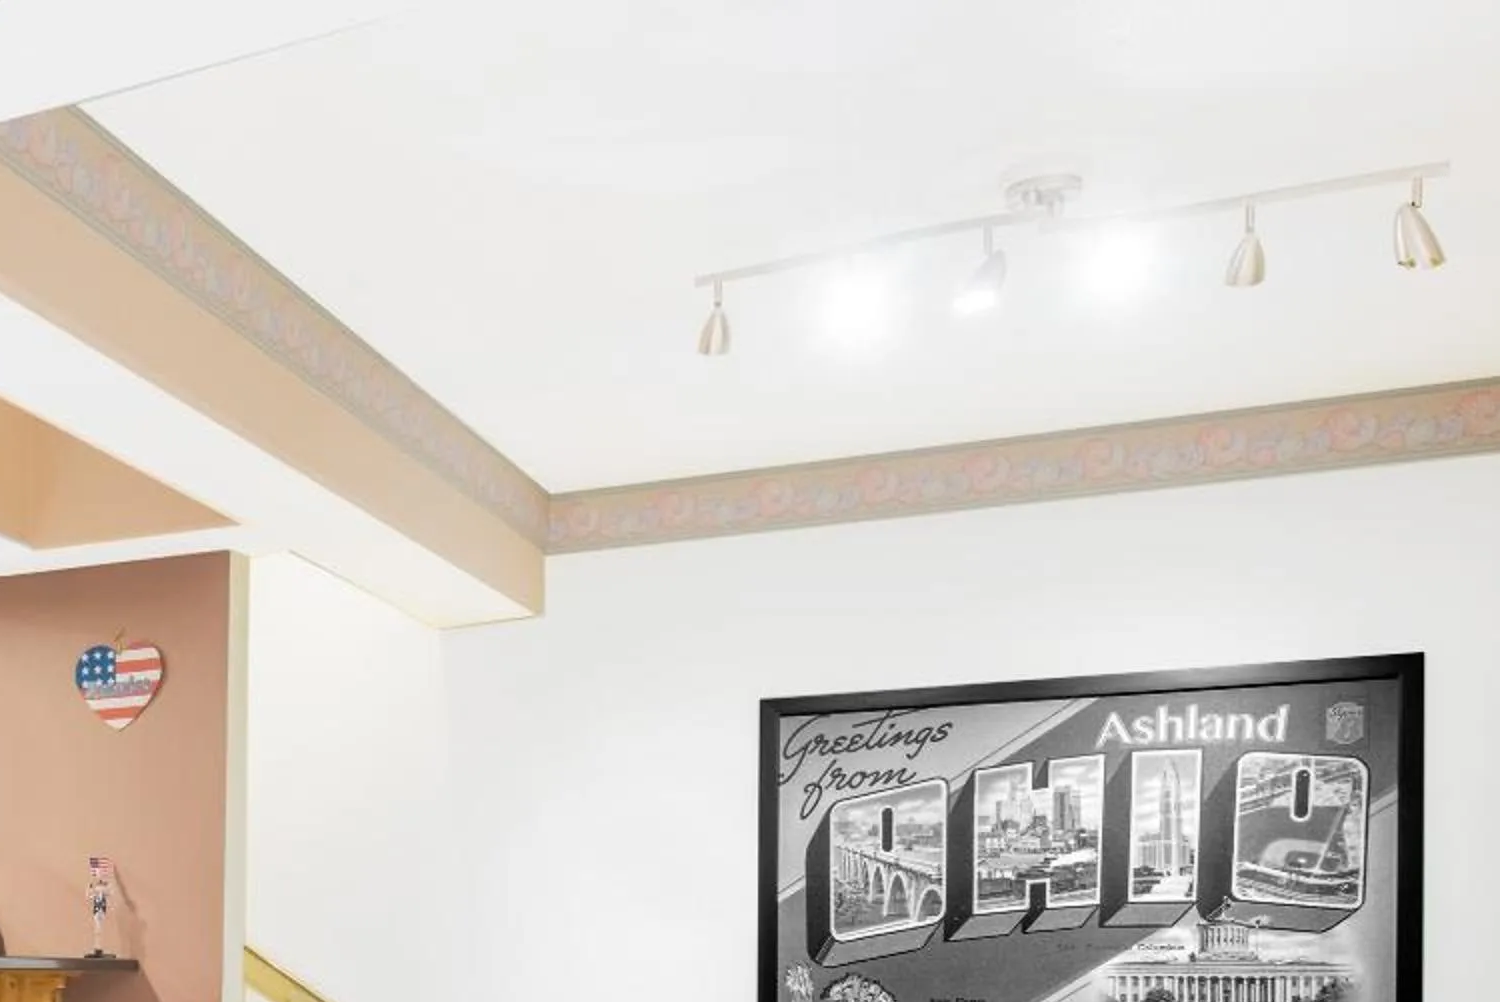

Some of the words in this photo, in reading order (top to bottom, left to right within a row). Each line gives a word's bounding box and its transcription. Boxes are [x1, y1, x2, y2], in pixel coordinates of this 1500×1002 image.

[777, 706, 953, 787] Greetings
[1095, 702, 1291, 749] Ashland
[799, 759, 917, 820] from
[808, 749, 1370, 967] OHIO
